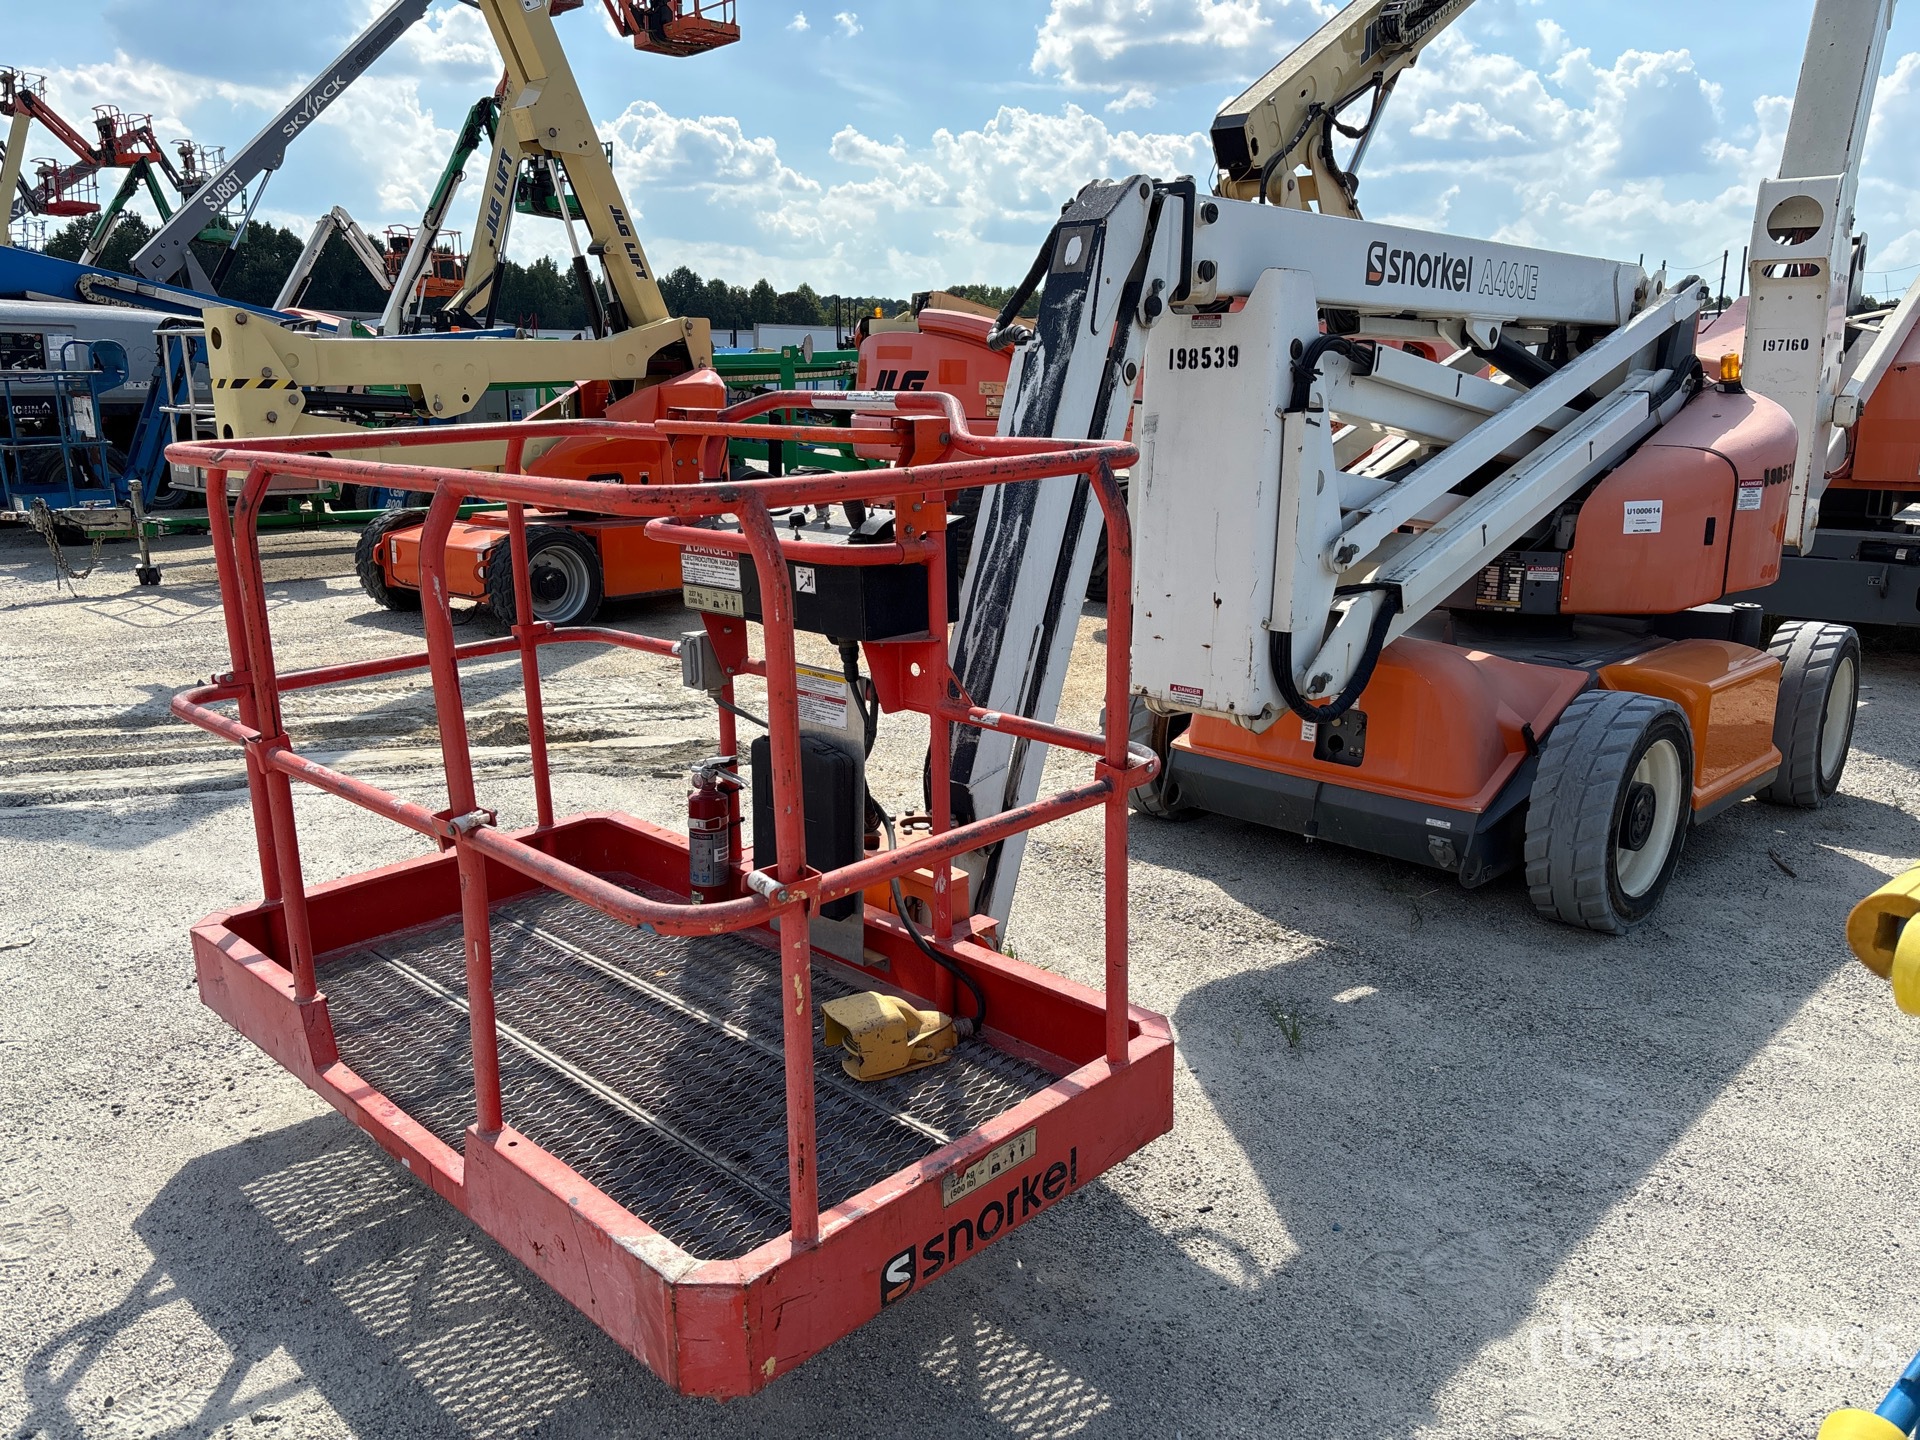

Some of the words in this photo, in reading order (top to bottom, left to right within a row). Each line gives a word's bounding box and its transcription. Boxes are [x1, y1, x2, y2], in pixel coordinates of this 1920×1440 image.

[282, 74, 347, 138] SKYJACK
[494, 147, 513, 198] LIFT
[203, 170, 244, 212] SJ86T
[486, 196, 503, 239] JLG
[608, 204, 632, 238] JLG
[623, 242, 649, 280] LIFT
[1387, 249, 1473, 293] snorkel
[1478, 258, 1539, 301] A46JE
[1168, 345, 1239, 370] 198539
[1762, 338, 1809, 352] 197160
[1626, 507, 1661, 515] U1000614
[682, 554, 719, 565] ELECTROCUTION
[719, 559, 739, 568] HAZARD
[696, 592, 703, 600] kg
[1177, 686, 1202, 695] DANGER
[966, 1169, 975, 1179] kg
[922, 1147, 1077, 1279] snorkel
